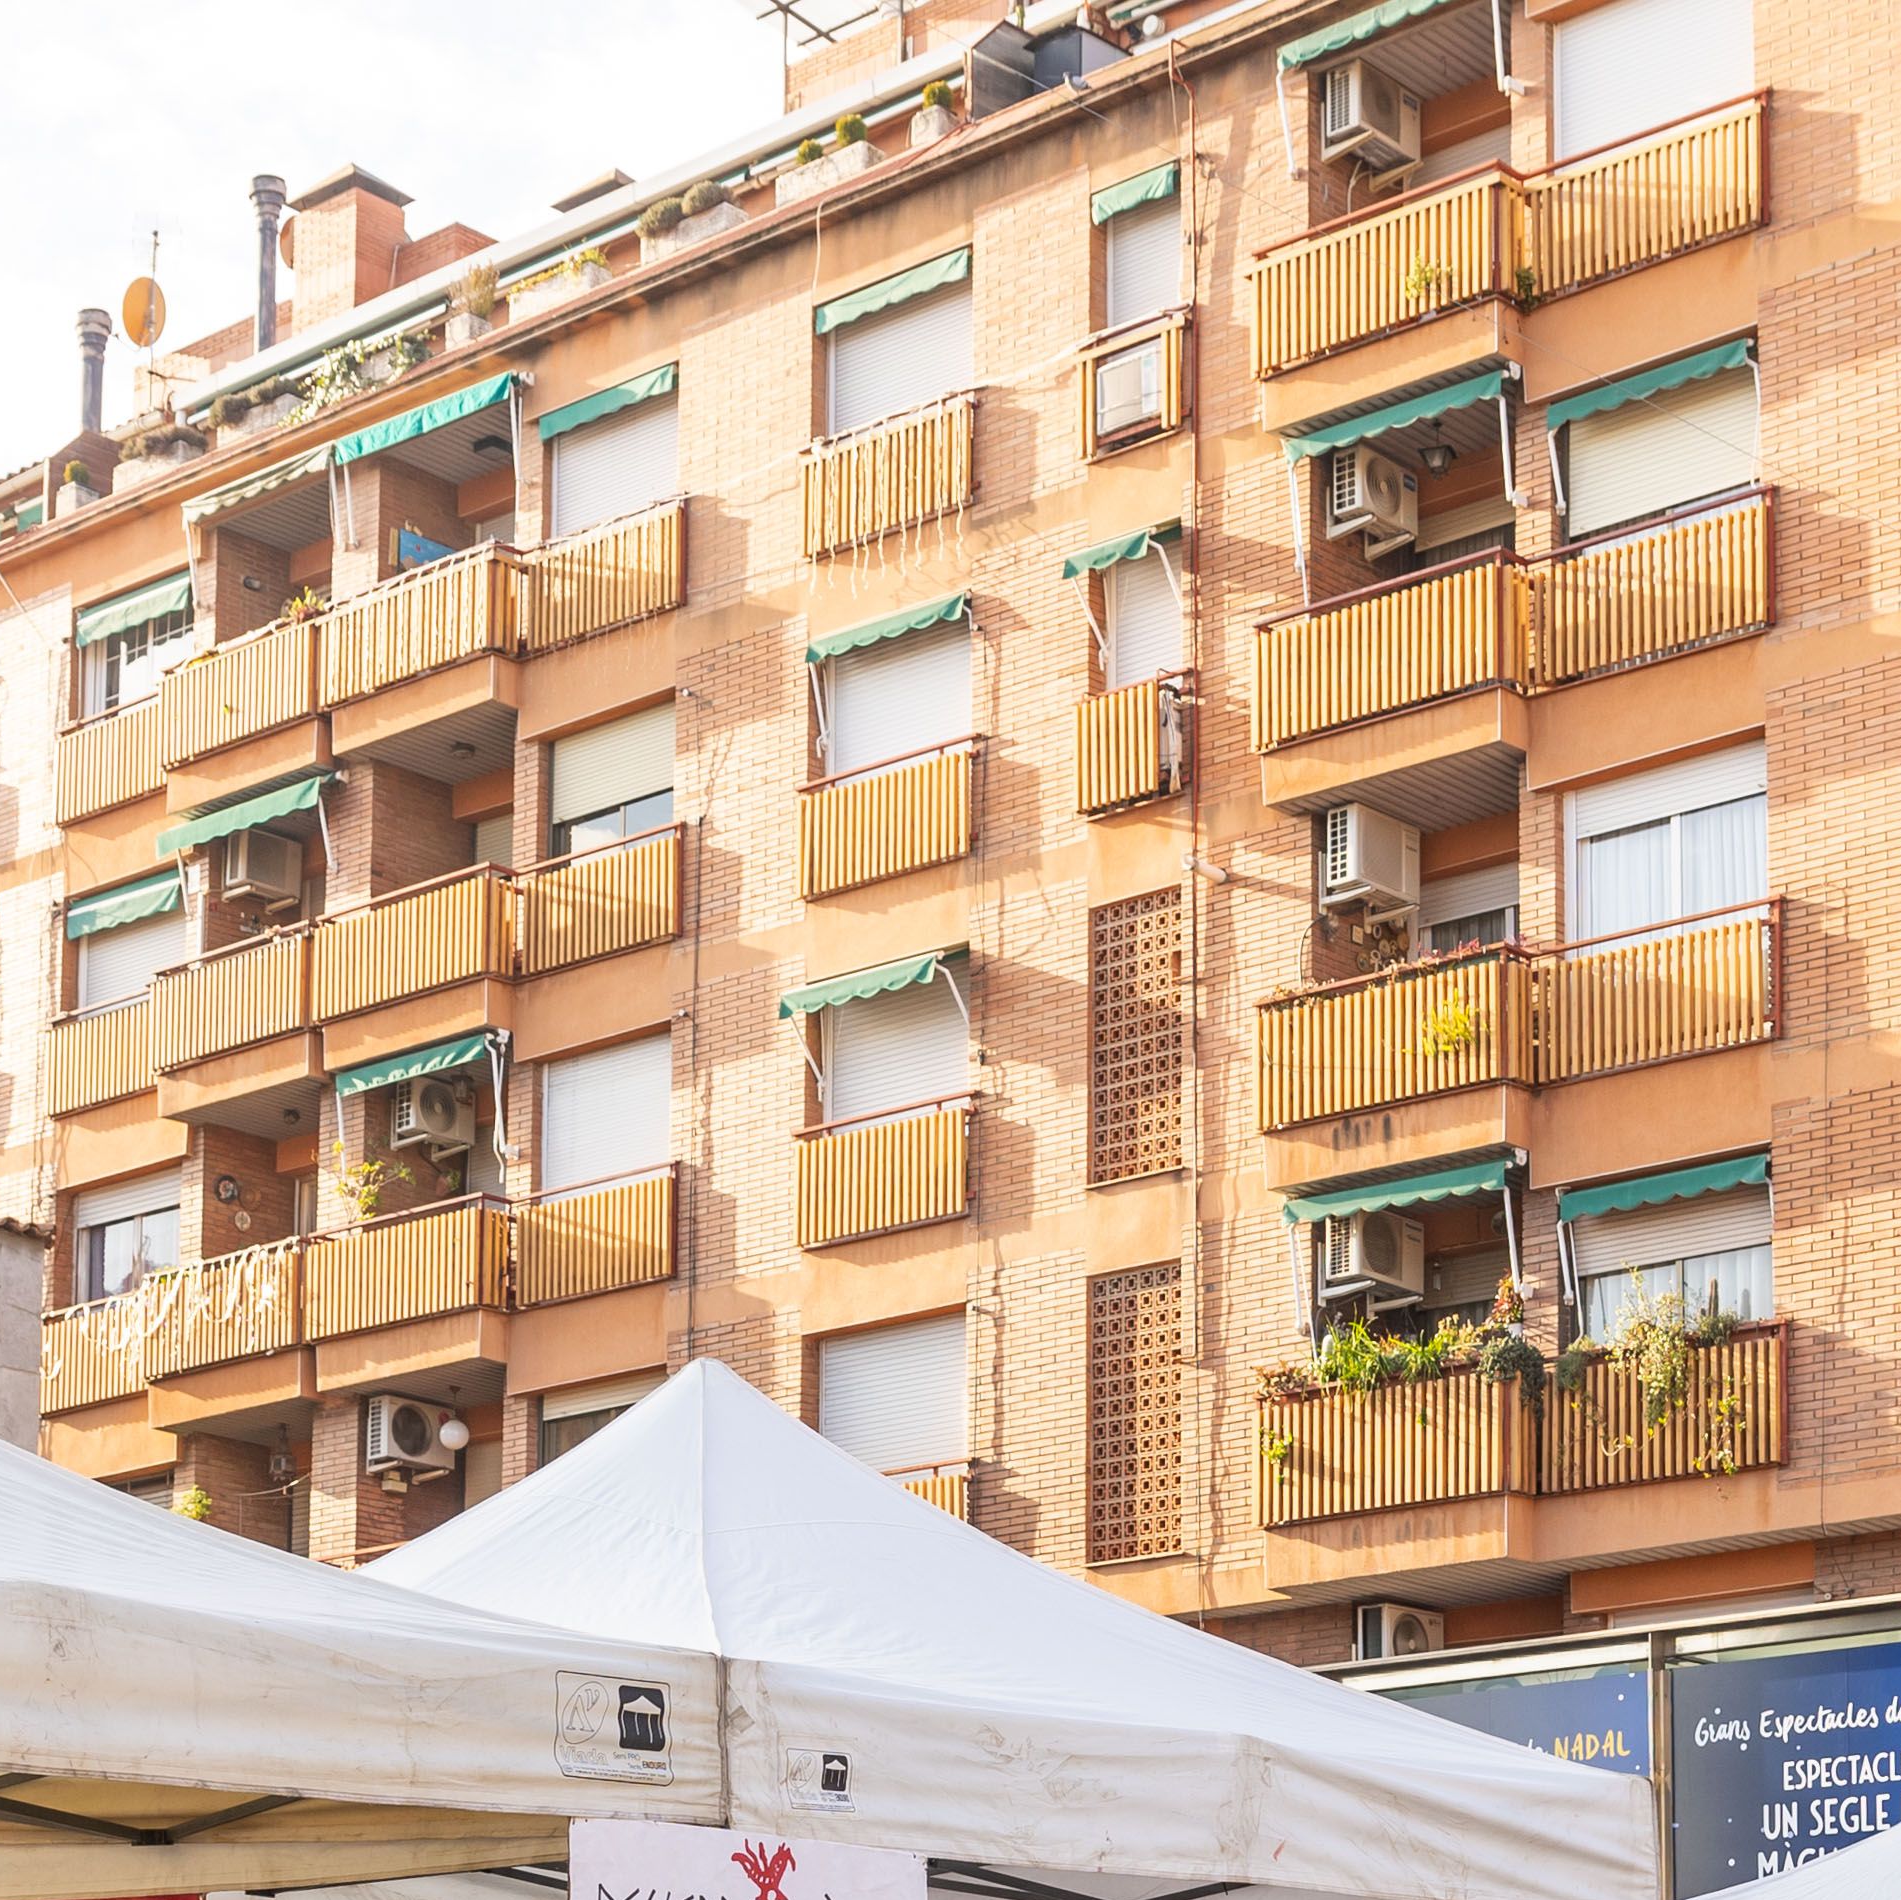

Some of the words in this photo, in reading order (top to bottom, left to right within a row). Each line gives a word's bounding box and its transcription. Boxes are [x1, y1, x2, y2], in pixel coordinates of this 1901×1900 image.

[1554, 1729, 1631, 1761] NADAL
[1694, 1717, 1751, 1747] Grans
[1759, 1702, 1879, 1743] Espectacles
[1763, 1801, 1798, 1840] UN
[1809, 1793, 1891, 1838] SEGLE
